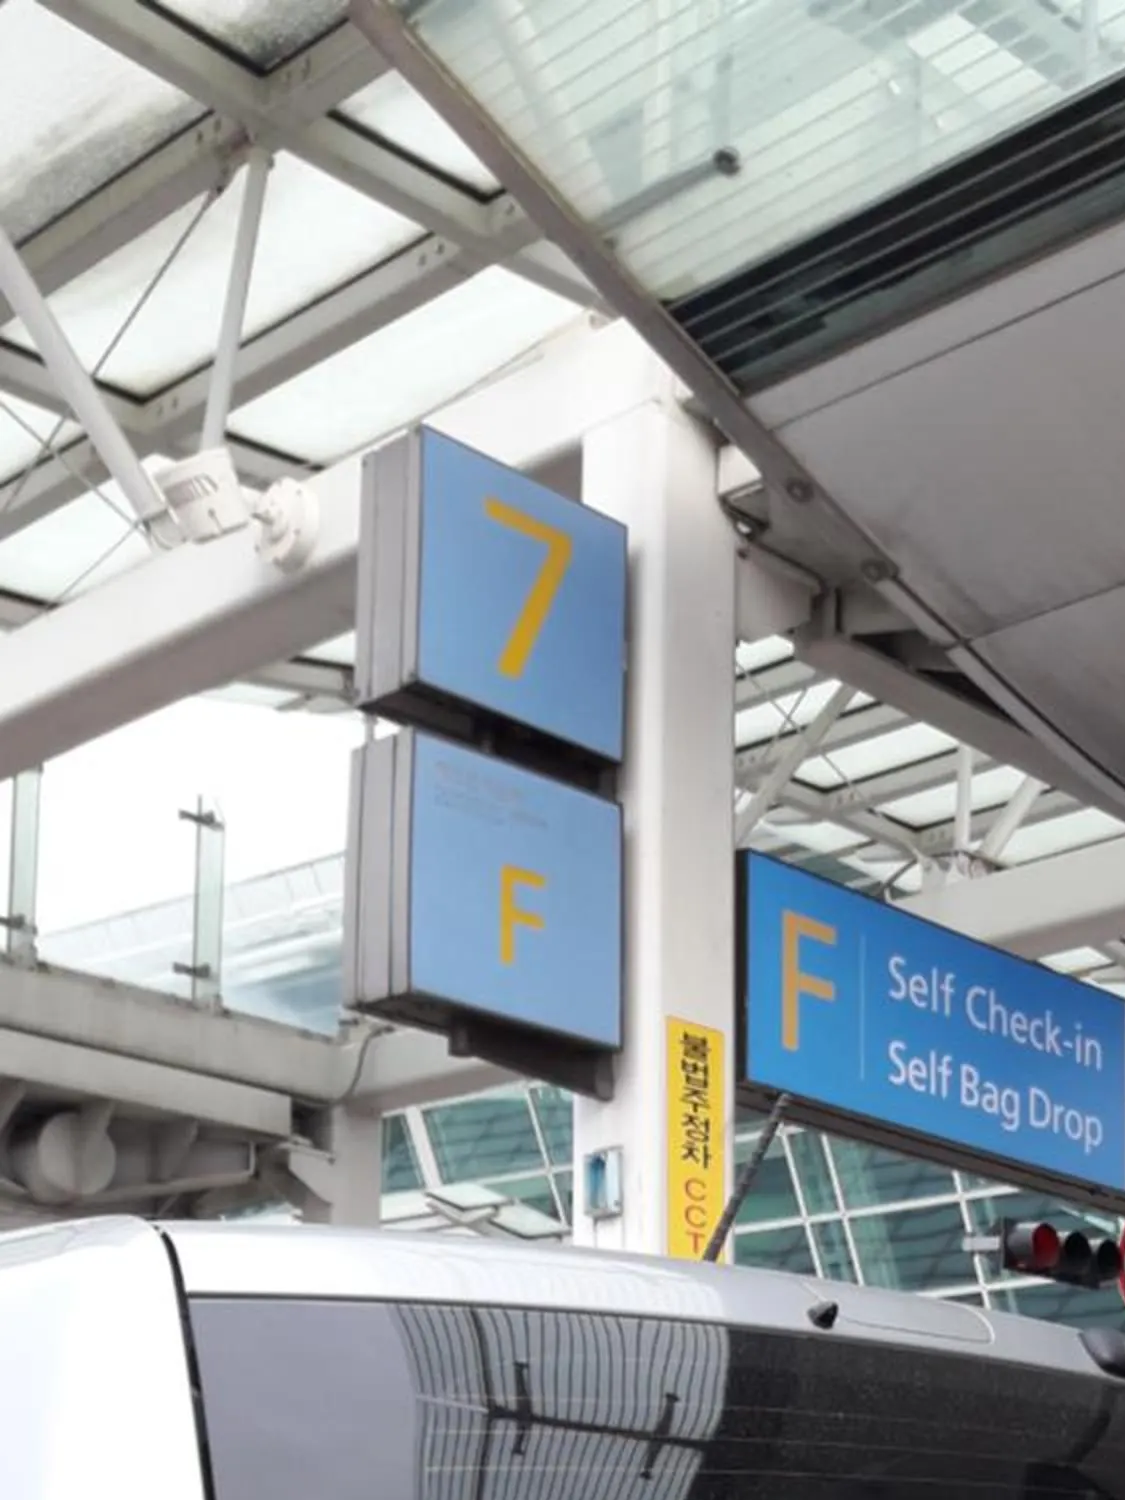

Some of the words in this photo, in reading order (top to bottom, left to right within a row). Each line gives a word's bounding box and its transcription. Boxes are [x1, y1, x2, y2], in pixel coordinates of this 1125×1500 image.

[484, 496, 572, 681] 7
[499, 864, 547, 967] F
[781, 909, 837, 1052] F
[888, 955, 957, 1018] Self
[965, 984, 1103, 1071] Check-in
[680, 1030, 713, 1169] 불법주정차
[887, 1039, 953, 1100] Self
[959, 1063, 1021, 1132] Bag
[1029, 1086, 1104, 1154] Drop
